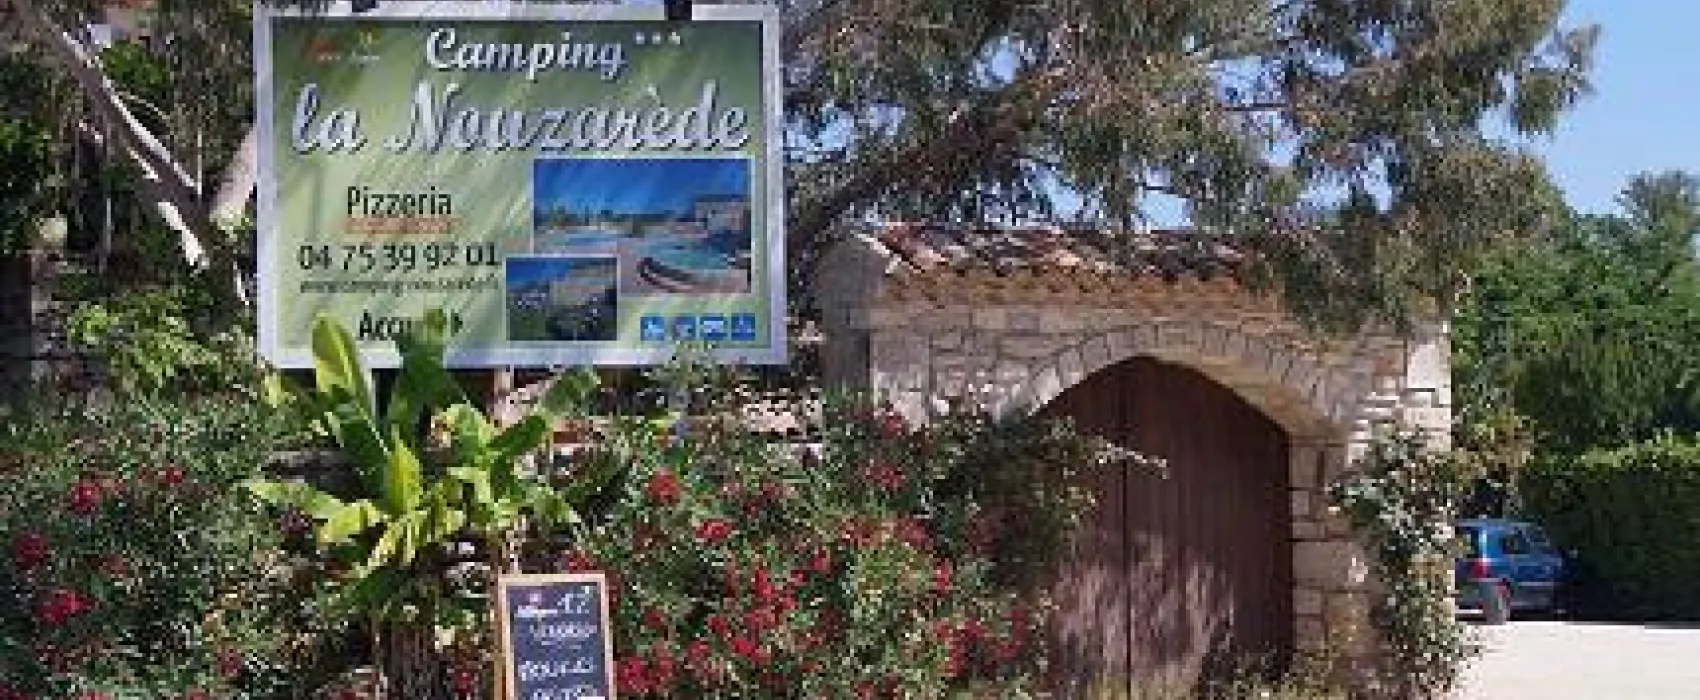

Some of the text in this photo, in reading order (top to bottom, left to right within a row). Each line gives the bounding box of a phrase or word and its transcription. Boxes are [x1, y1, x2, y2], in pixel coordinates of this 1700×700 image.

[426, 27, 628, 81] Camping
[292, 79, 750, 153] la Nouzarède
[346, 185, 452, 217] Pizzeria
[298, 242, 499, 272] 04 75 39 92 01
[358, 308, 440, 342] Accu
